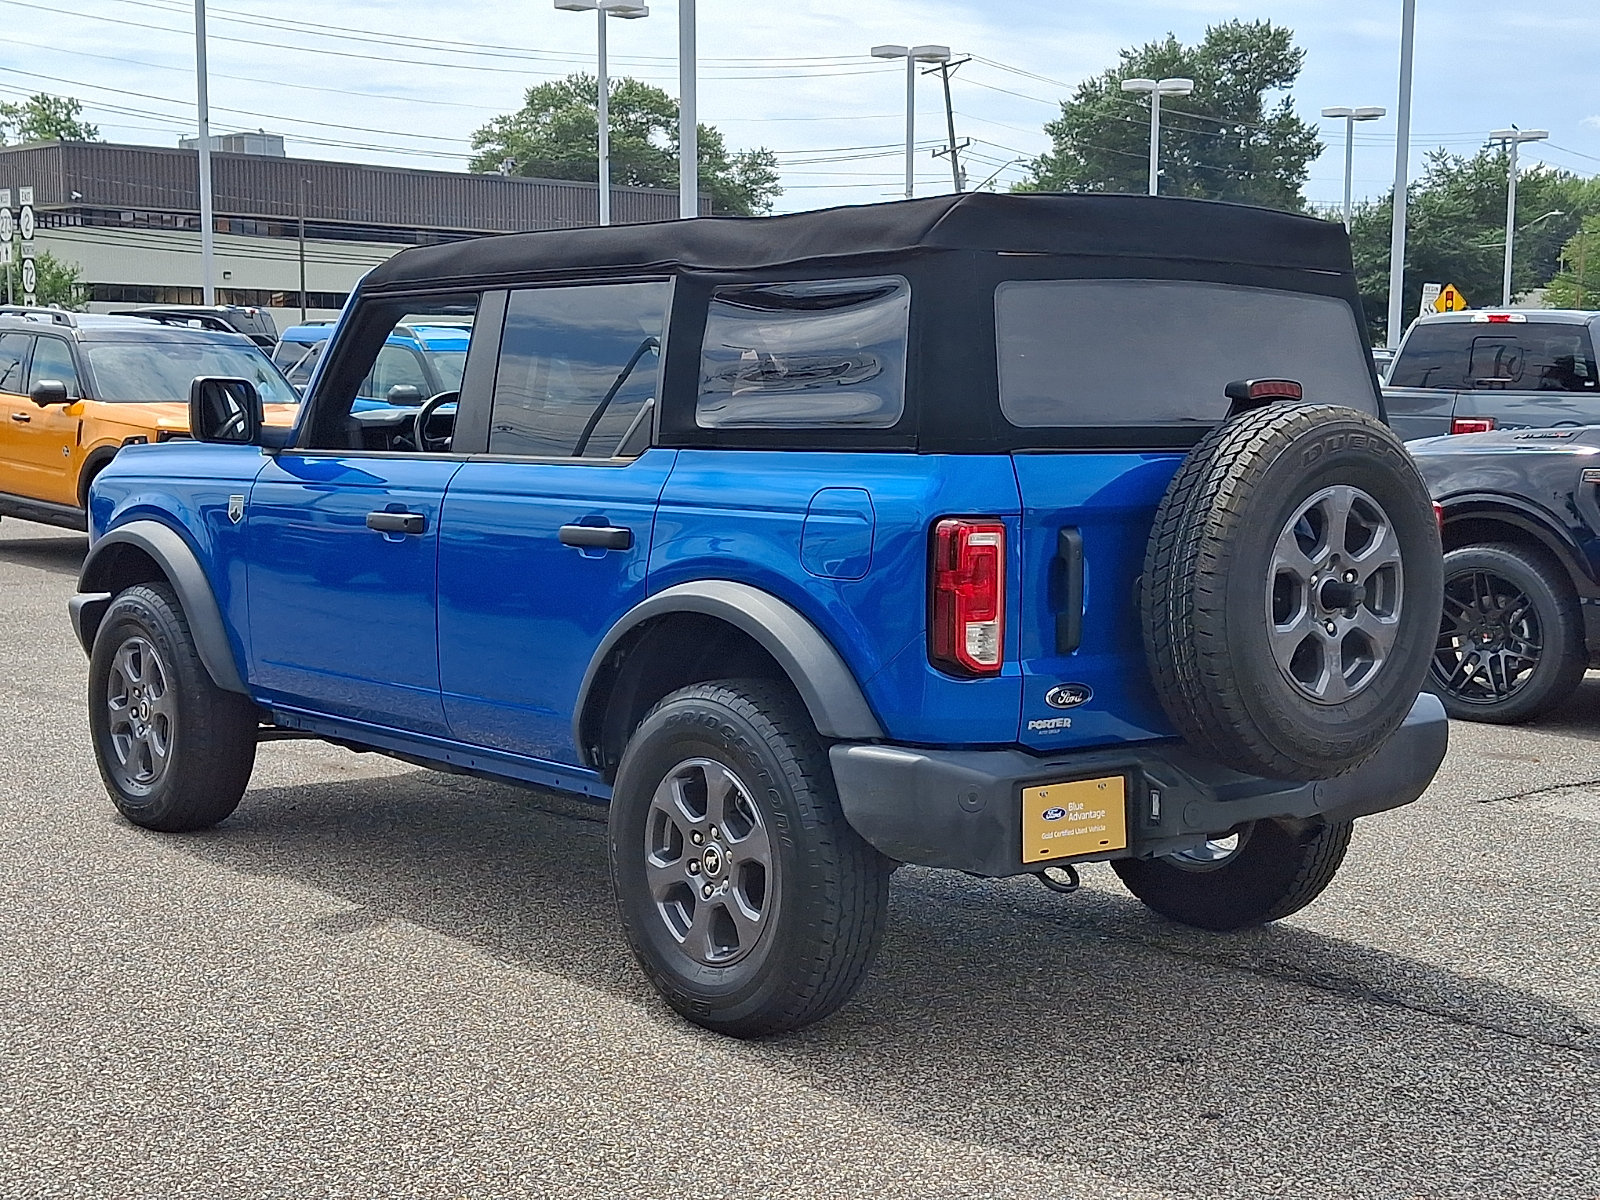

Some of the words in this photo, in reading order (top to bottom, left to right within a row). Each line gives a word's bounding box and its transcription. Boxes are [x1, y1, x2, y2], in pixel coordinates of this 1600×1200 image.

[24, 213, 31, 232] 2
[24, 266, 34, 285] 72
[1058, 690, 1083, 704] Ford
[1028, 718, 1072, 730] PORTER
[1068, 802, 1084, 811] Blue
[1068, 810, 1106, 821] Advantage
[1041, 832, 1054, 840] Gold
[1053, 828, 1075, 837] Certified
[1075, 826, 1088, 835] Used
[1088, 824, 1106, 833] Vehicle
